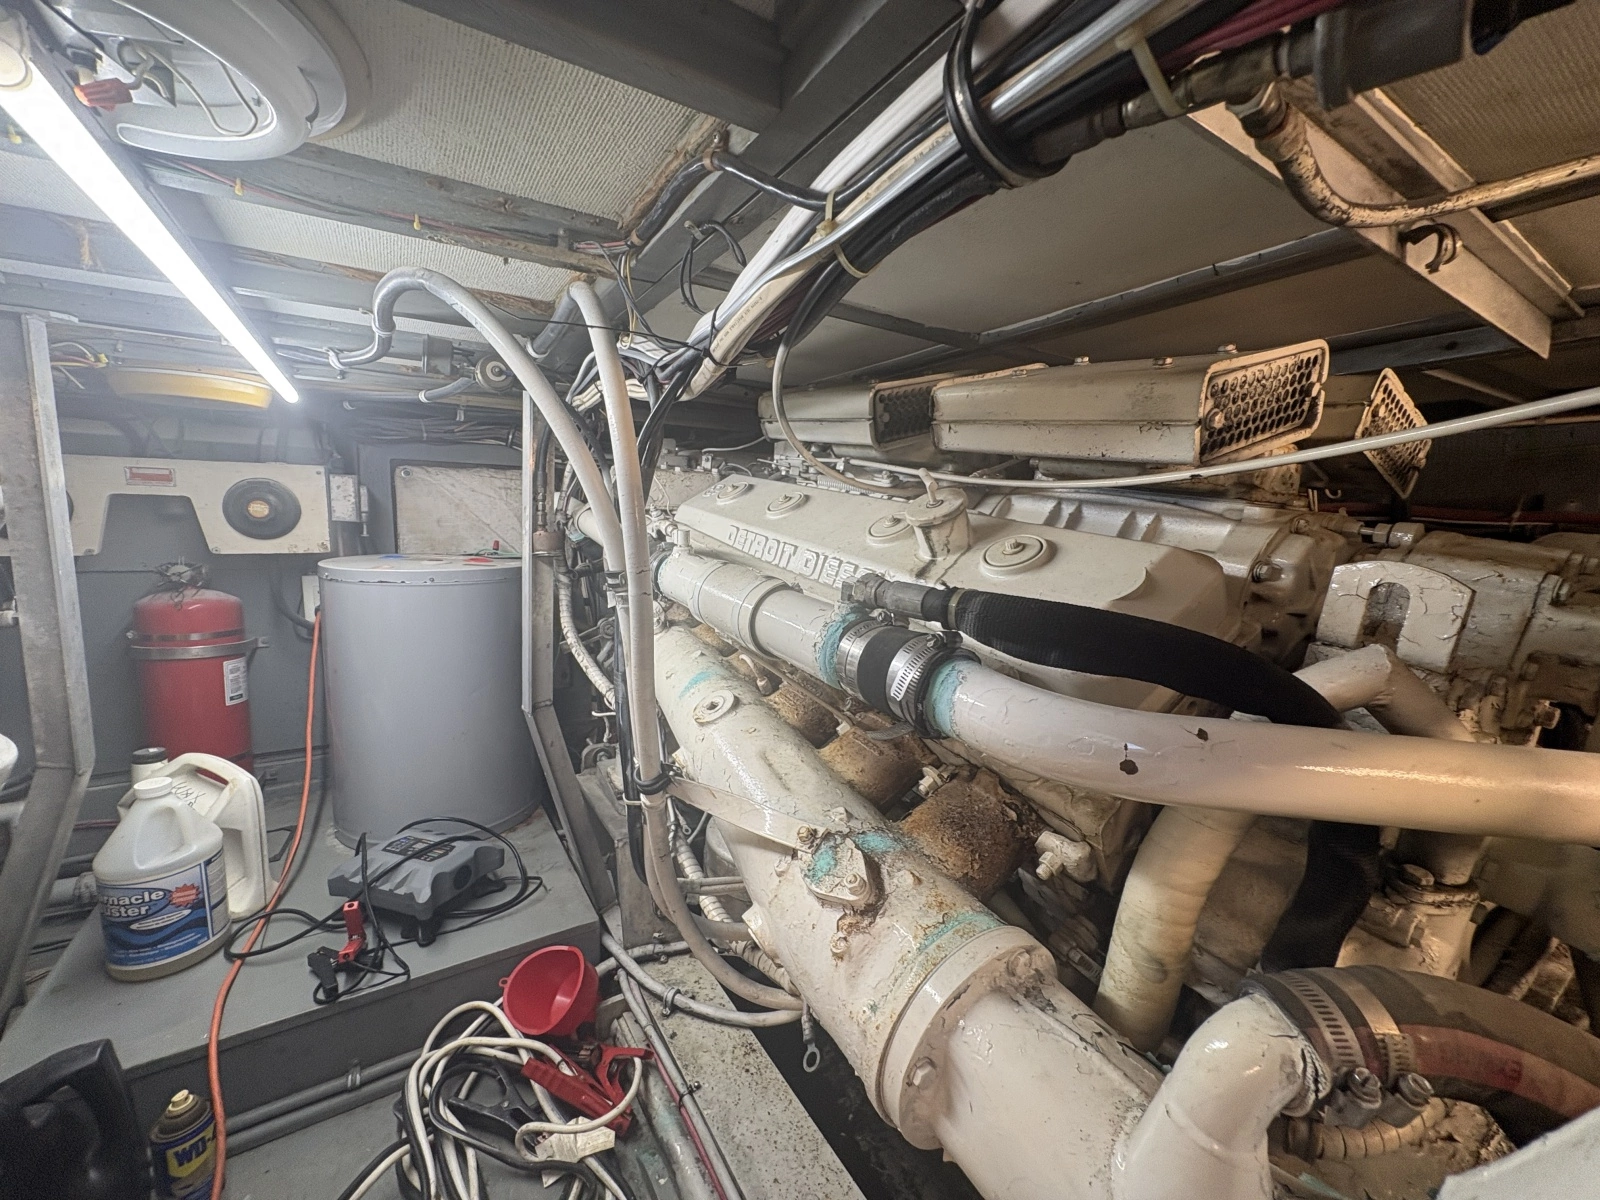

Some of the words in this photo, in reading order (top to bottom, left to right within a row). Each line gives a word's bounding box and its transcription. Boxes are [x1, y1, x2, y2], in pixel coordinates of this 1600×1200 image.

[727, 525, 799, 569] DETROIT
[801, 549, 884, 588] DIES
[103, 890, 165, 906] rnacle
[104, 904, 149, 918] uster
